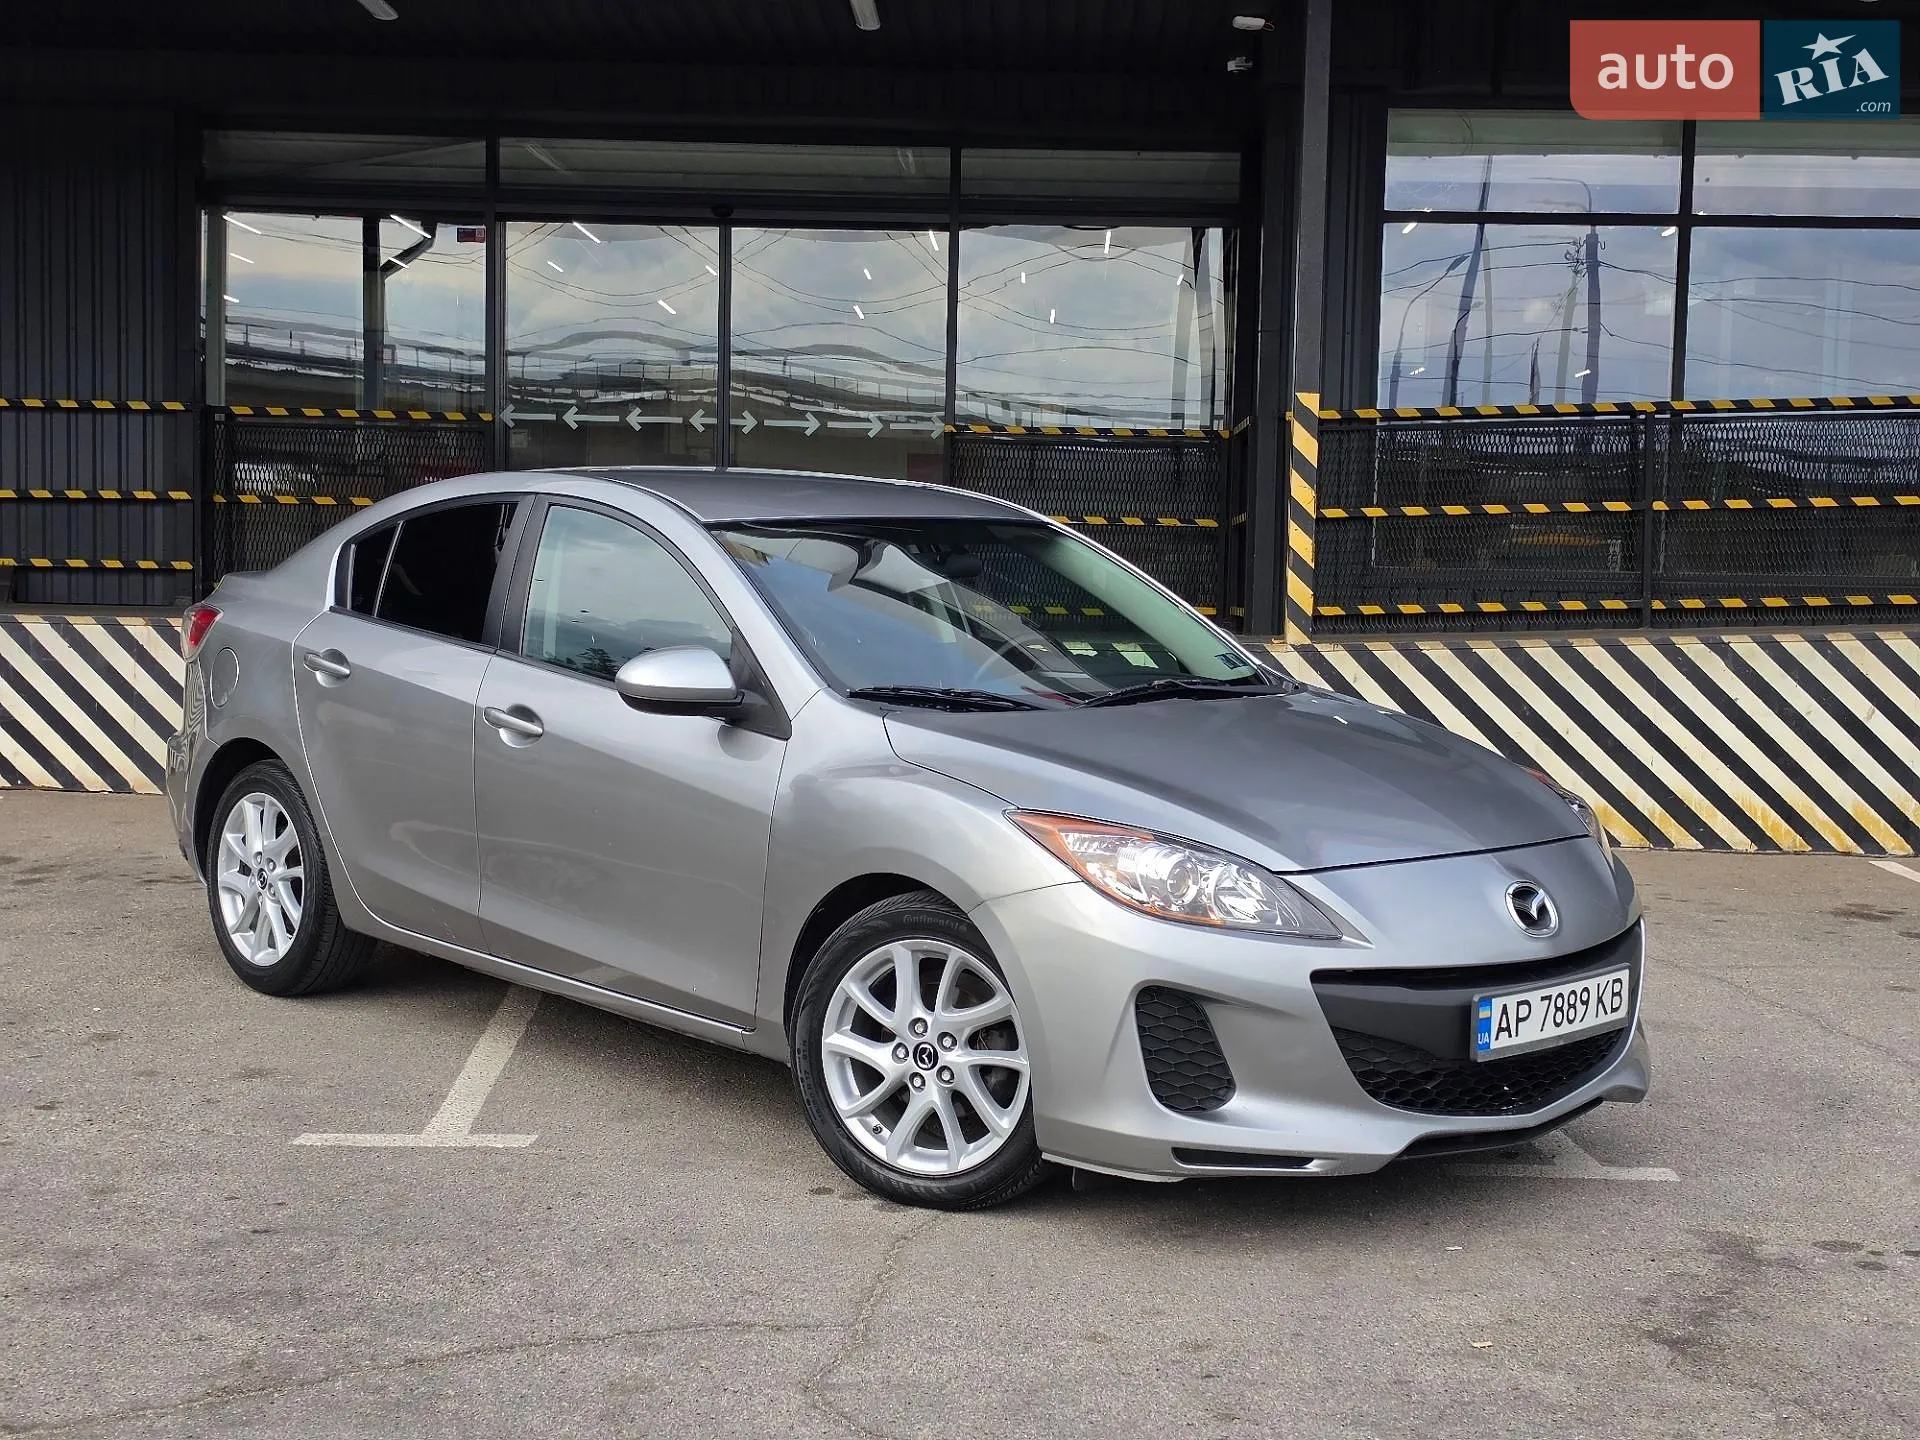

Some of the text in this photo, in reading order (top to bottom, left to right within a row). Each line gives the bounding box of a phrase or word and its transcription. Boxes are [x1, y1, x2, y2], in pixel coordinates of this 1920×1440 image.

[1494, 977, 1623, 1042] AP 7889 KB
[1477, 1031, 1490, 1045] UA
